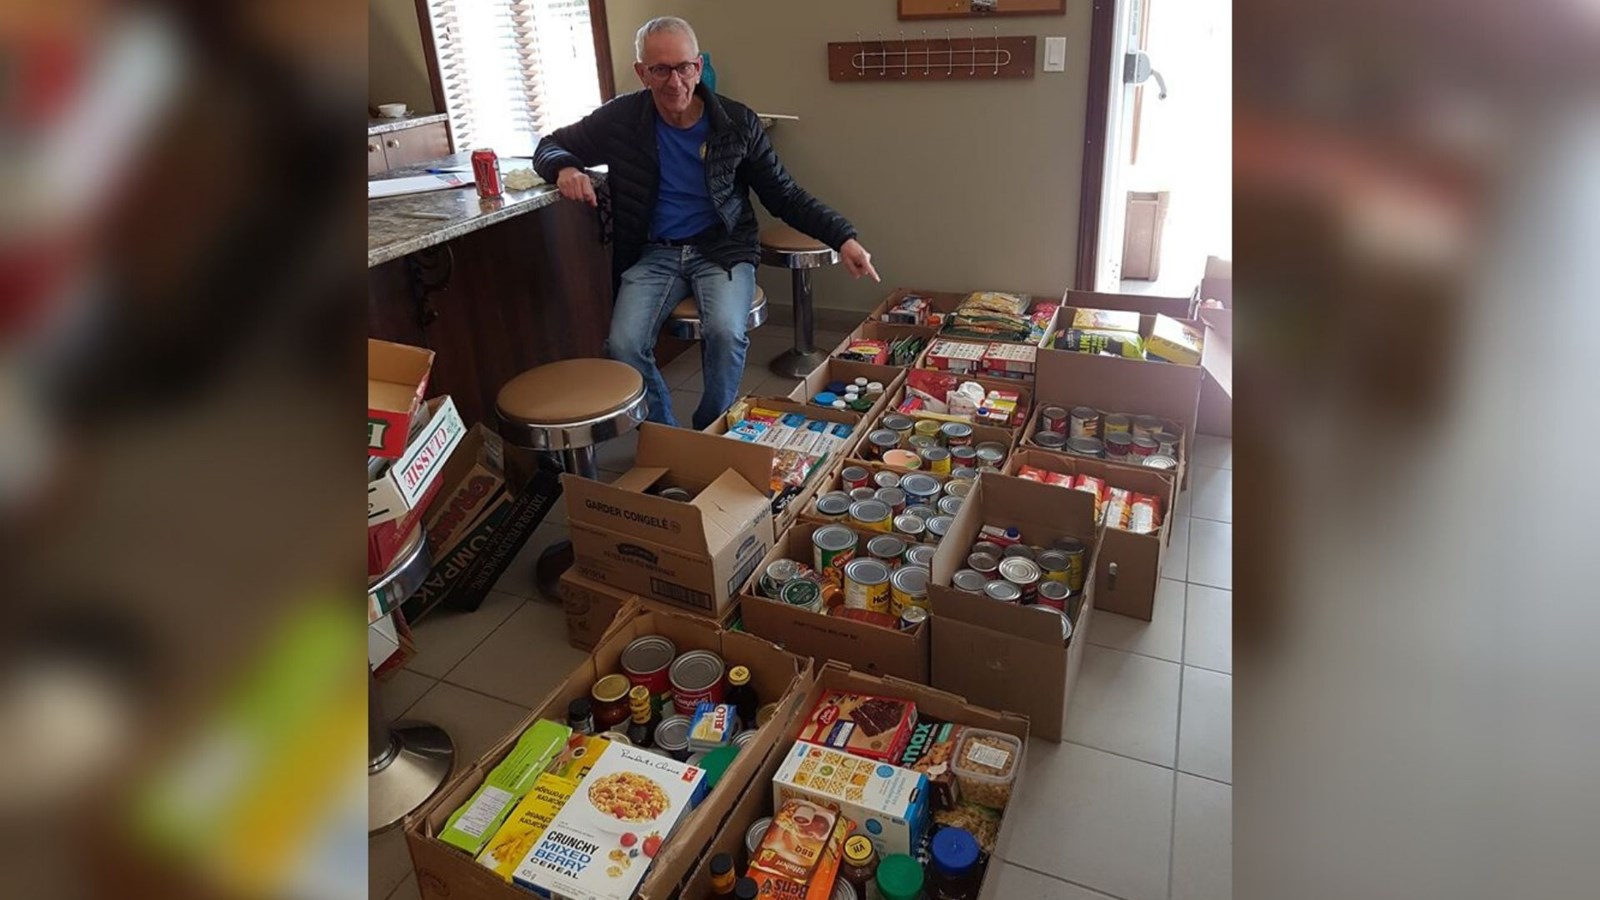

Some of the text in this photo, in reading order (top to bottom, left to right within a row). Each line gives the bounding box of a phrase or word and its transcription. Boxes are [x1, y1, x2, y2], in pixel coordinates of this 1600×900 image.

[585, 499, 669, 530] GARDER CONGELÉ
[903, 722, 932, 763] max
[537, 794, 567, 807] acaroni
[520, 817, 548, 830] acaroni
[540, 840, 591, 864] MIXED
[547, 830, 600, 855] CRUNCHY
[795, 844, 814, 858] BBQ
[530, 857, 579, 880] CEREAL
[535, 848, 587, 873] BERRY
